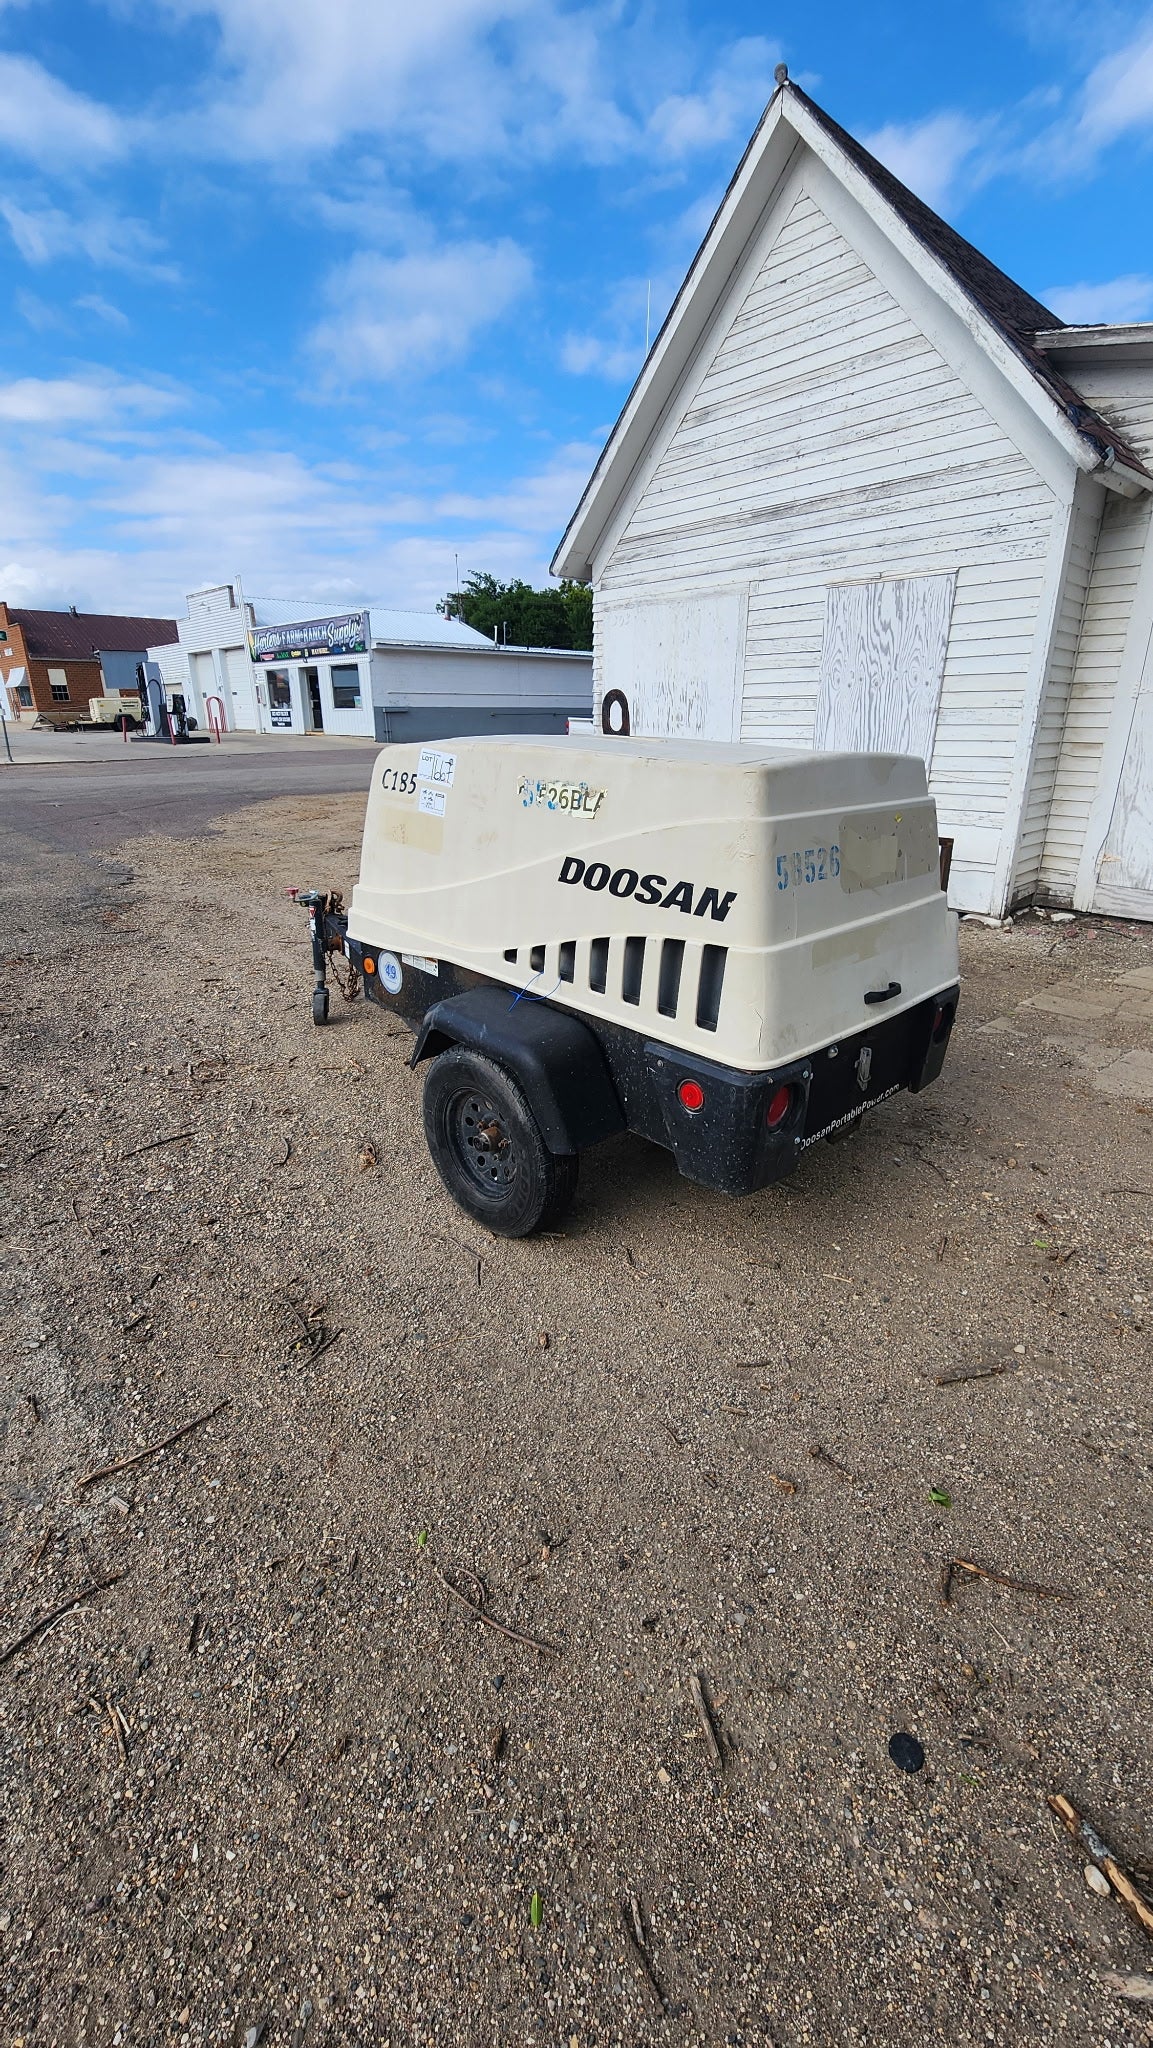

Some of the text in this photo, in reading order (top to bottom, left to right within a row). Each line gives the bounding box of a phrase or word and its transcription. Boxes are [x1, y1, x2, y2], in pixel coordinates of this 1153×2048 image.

[281, 630, 300, 645] FARM
[303, 626, 327, 642] RANCH
[327, 618, 360, 648] Supply
[421, 755, 433, 763] LOT
[381, 768, 417, 794] C185
[776, 845, 841, 891] 58526
[558, 856, 738, 922] DOOSAN
